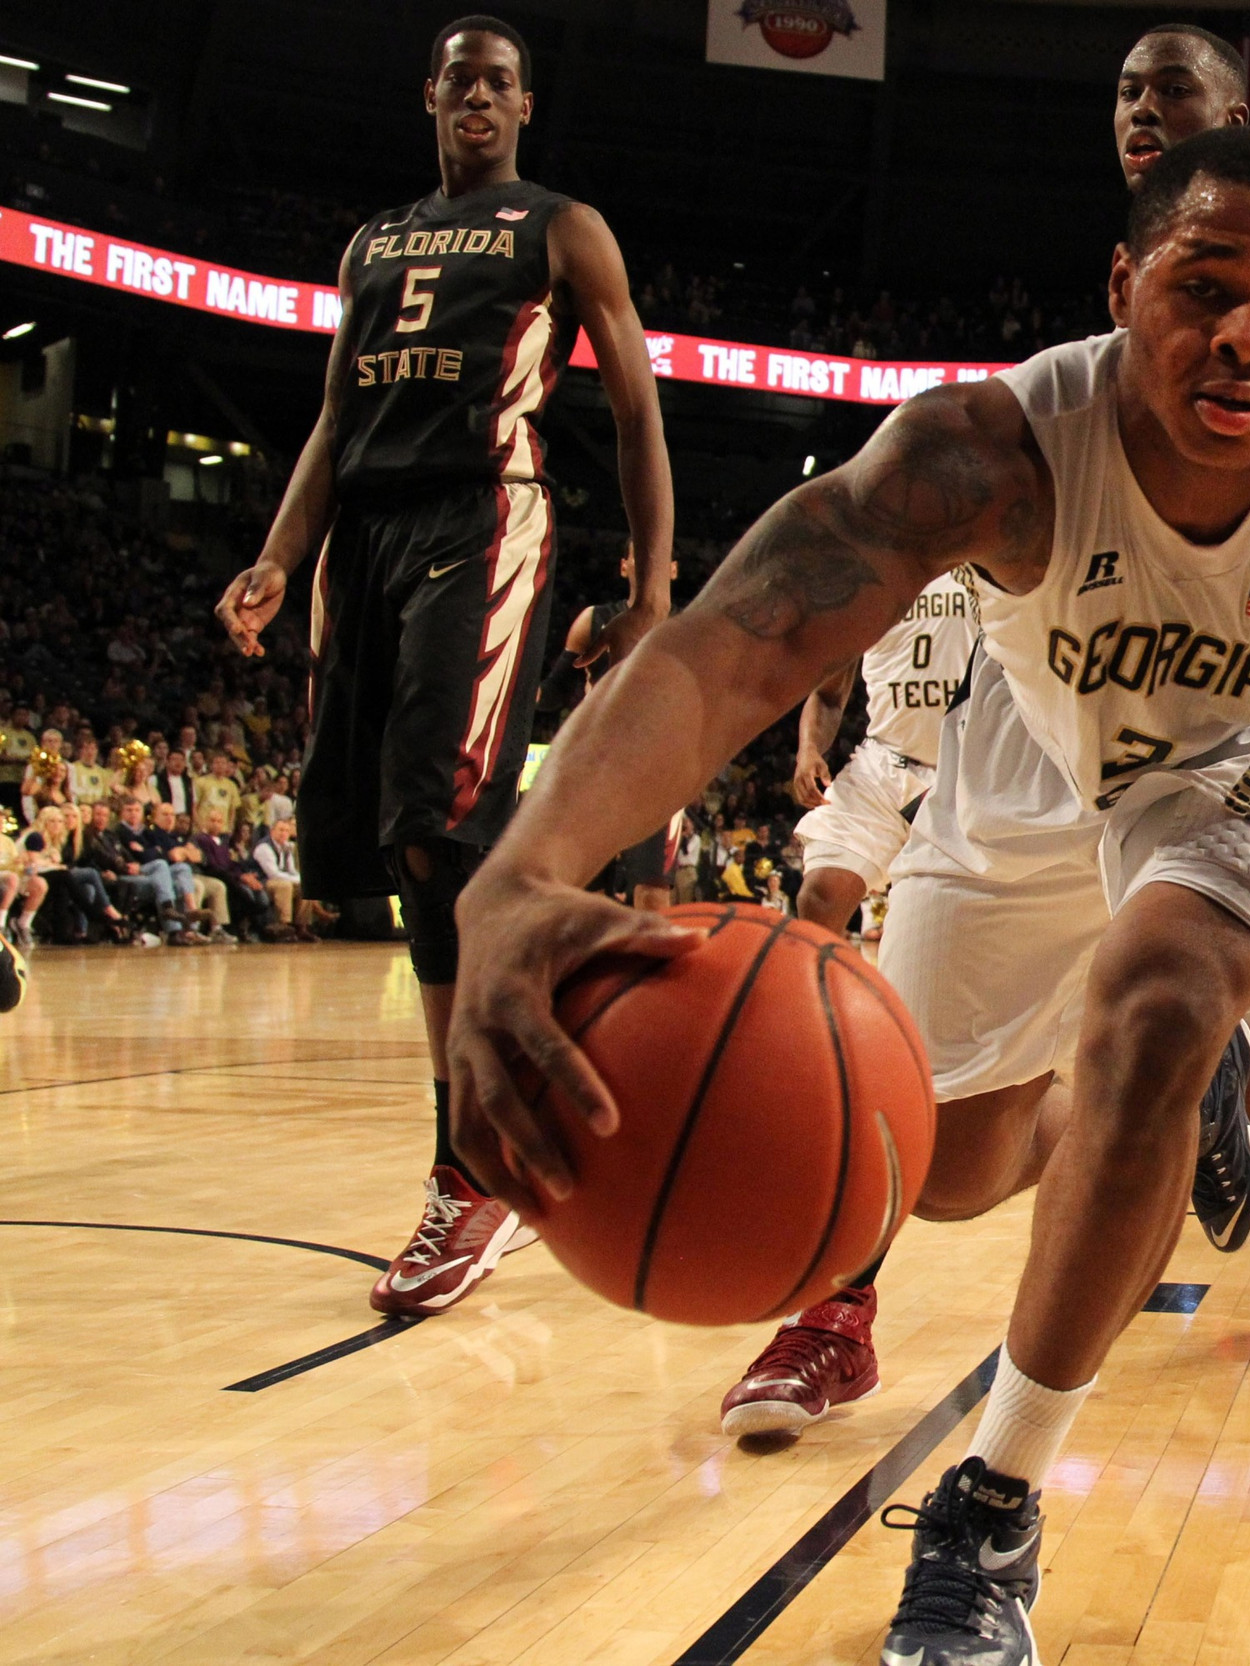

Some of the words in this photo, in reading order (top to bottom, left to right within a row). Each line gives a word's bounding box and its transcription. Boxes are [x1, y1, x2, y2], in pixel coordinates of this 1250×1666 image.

[774, 13, 819, 32] 1990
[363, 228, 514, 266] FLORIDA
[30, 223, 94, 275] THE
[106, 243, 196, 299] FIRST
[205, 270, 298, 324] NAME
[313, 291, 343, 328] IN
[394, 265, 443, 333] 5
[357, 347, 463, 387] STATE
[698, 344, 756, 384] THE
[767, 353, 850, 395] FIRST
[912, 633, 932, 669] 0
[888, 679, 961, 709] TECH
